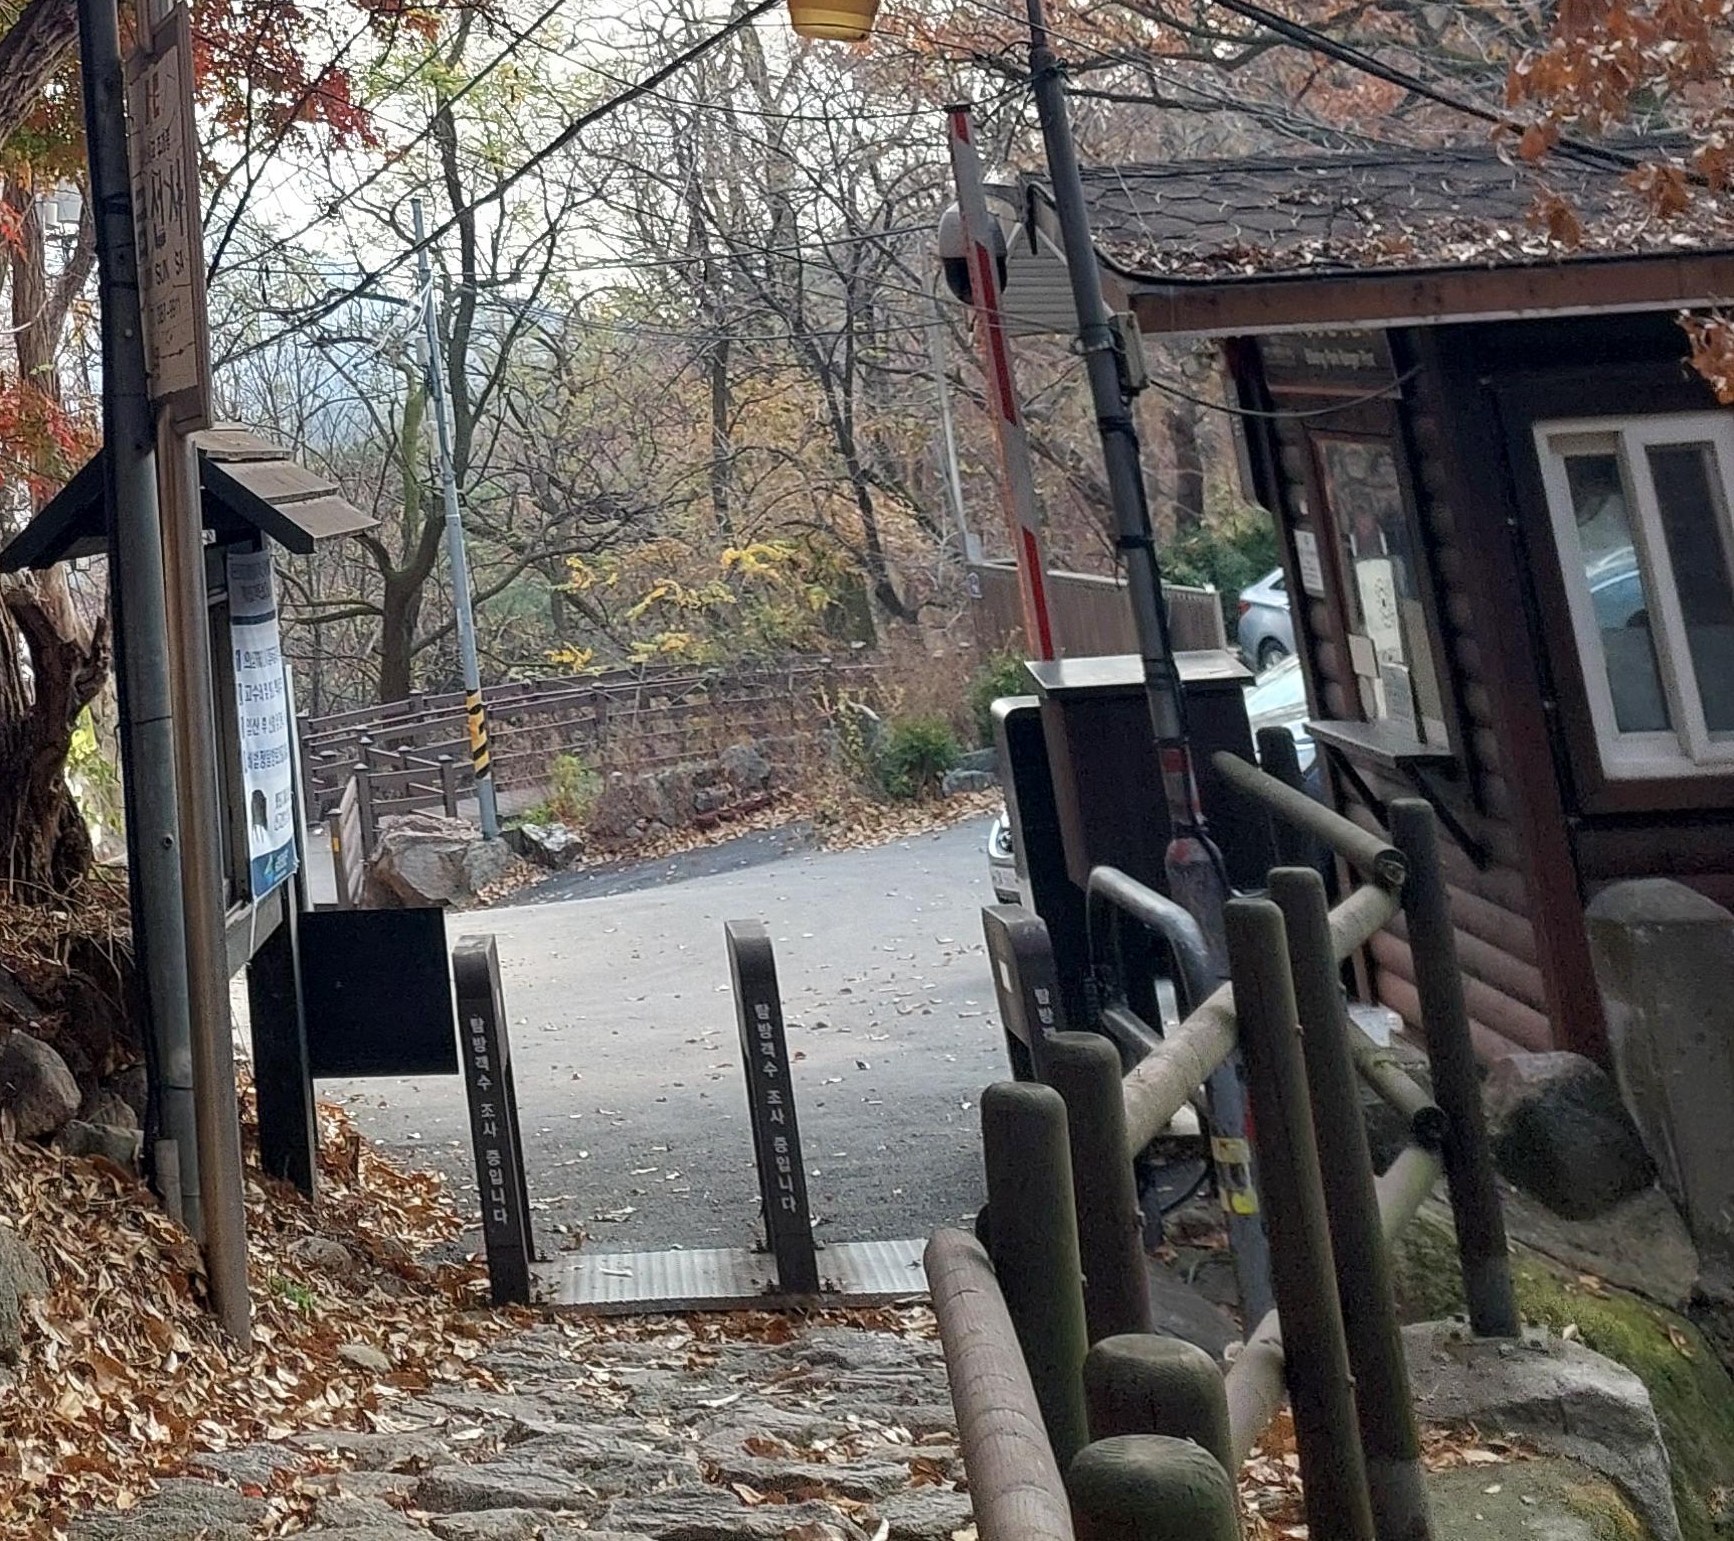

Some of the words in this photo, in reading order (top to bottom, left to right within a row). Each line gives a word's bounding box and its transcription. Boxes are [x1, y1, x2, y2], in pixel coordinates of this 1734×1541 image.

[469, 1017, 493, 1091] 탐방객수
[753, 1003, 779, 1078] 탐방객수
[480, 1102, 498, 1139] 조사
[766, 1089, 784, 1125] 조사
[485, 1149, 508, 1225] 중입니다
[773, 1136, 797, 1213] 중입니다
